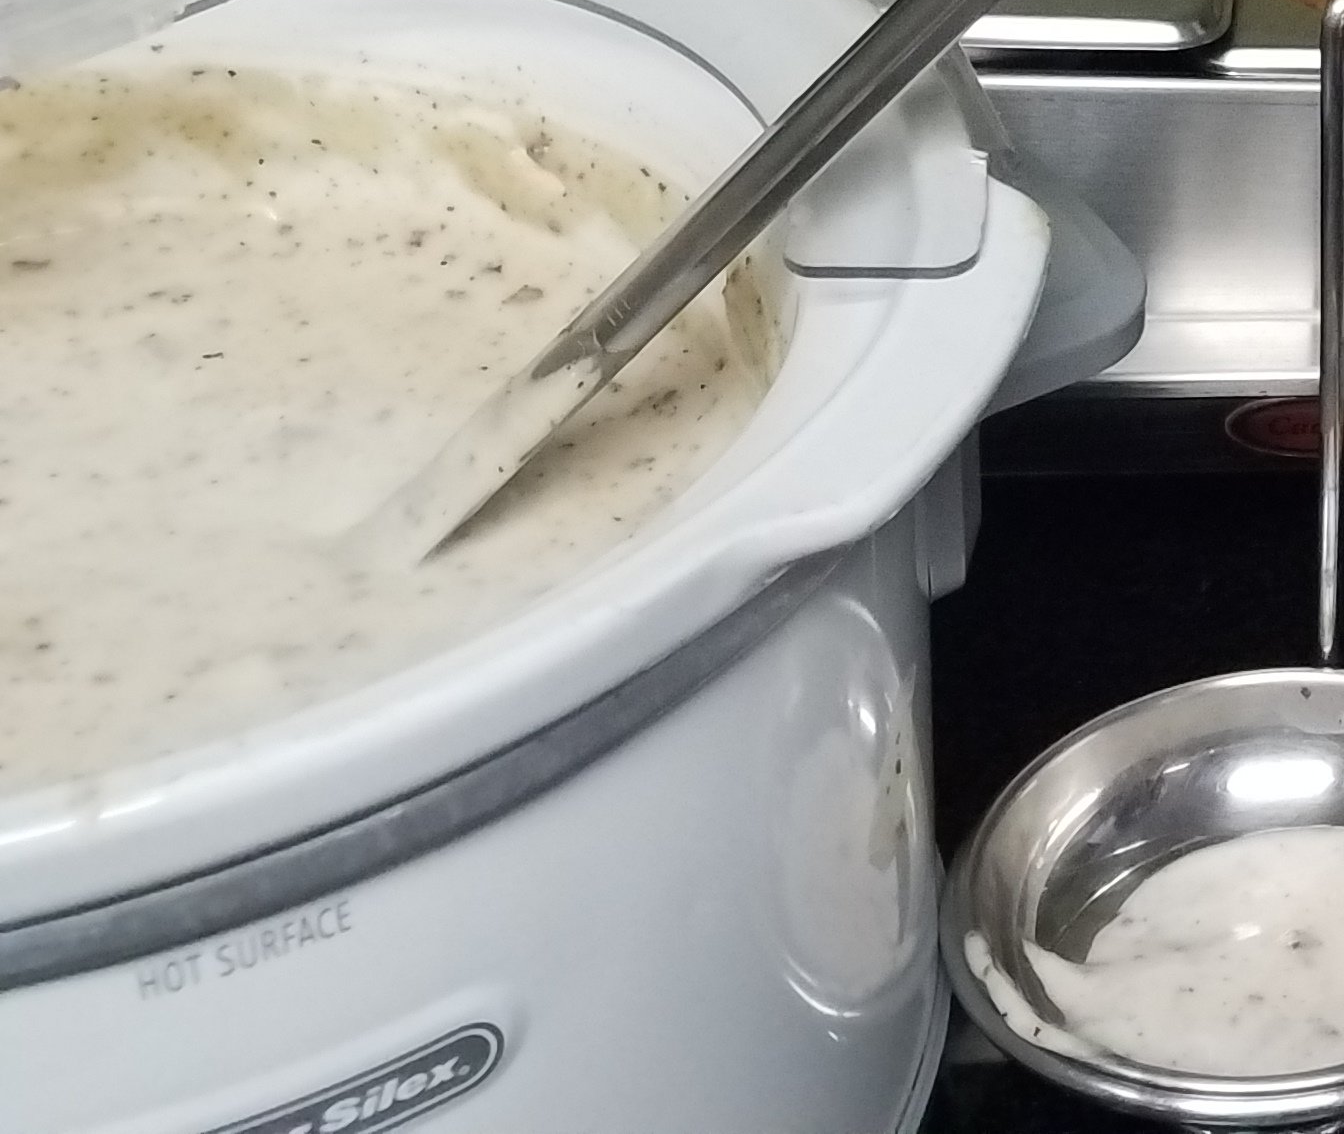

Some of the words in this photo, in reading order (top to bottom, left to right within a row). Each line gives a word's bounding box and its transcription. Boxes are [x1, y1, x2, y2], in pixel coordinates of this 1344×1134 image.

[137, 953, 201, 1001] HOT
[215, 900, 352, 978] SURFACE
[319, 1055, 460, 1134] Silex
